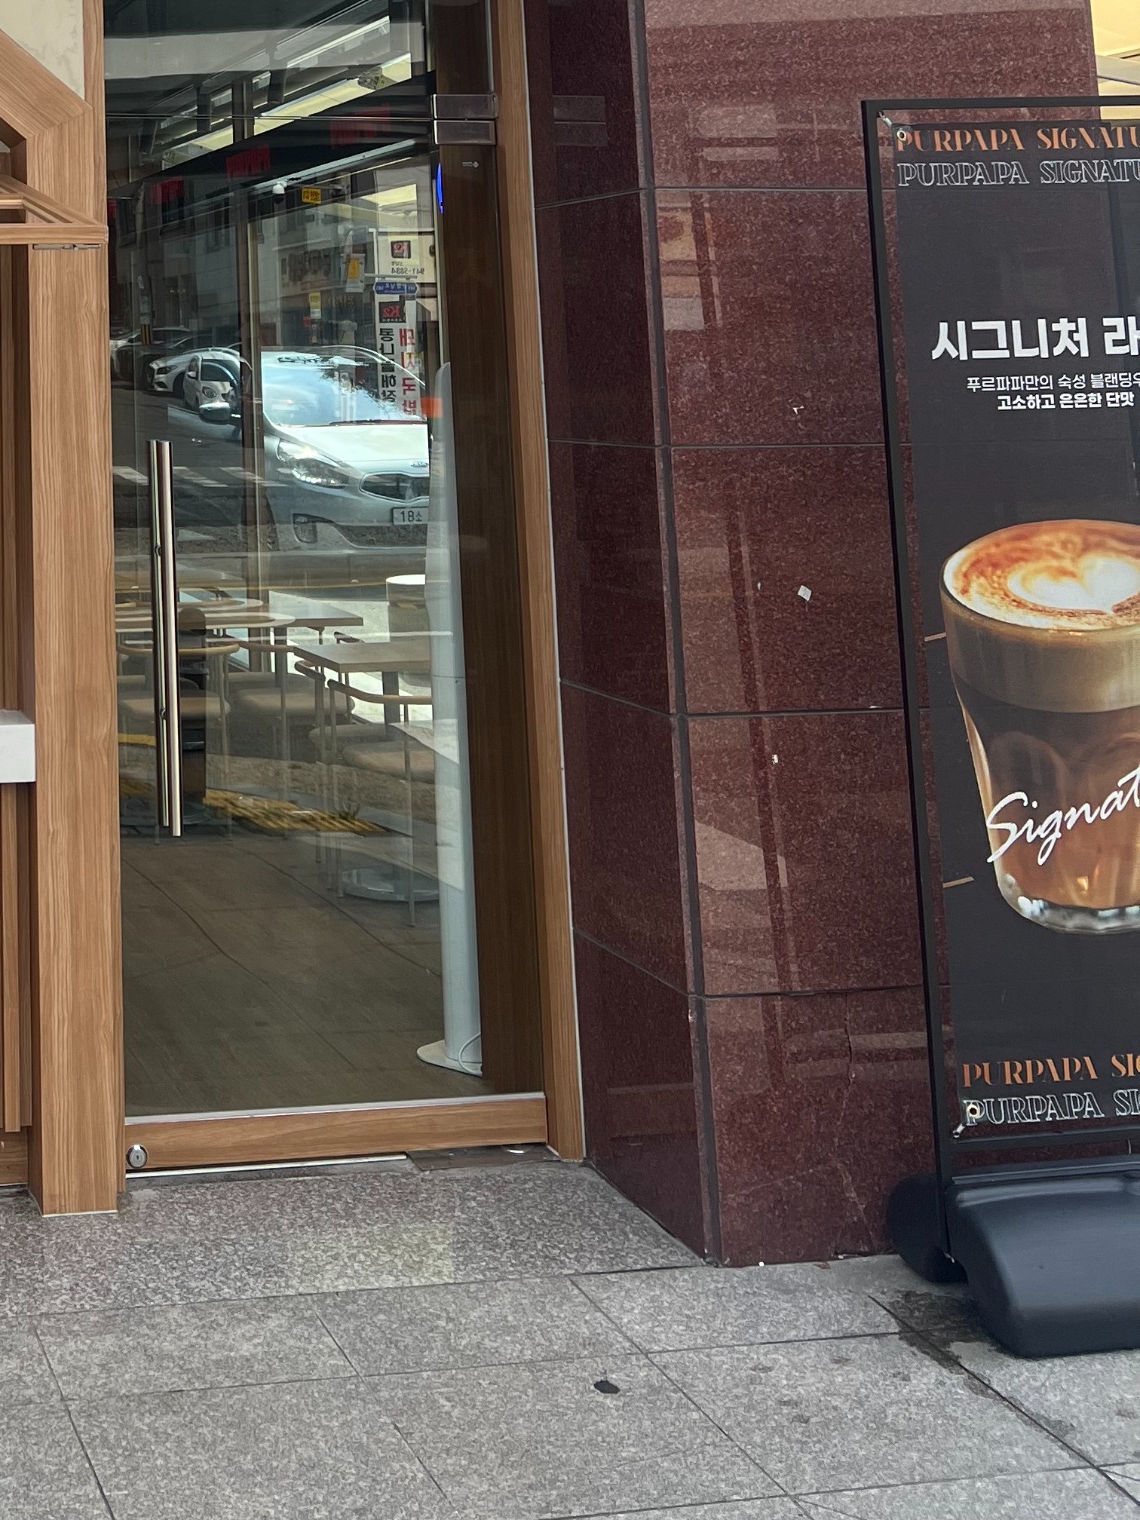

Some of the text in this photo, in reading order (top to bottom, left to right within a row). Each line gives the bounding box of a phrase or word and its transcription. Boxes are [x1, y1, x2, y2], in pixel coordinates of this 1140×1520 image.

[897, 128, 1026, 152] PURPAPA
[897, 160, 1029, 186] PURPAPA
[932, 318, 1089, 360] 시그니처
[967, 375, 1054, 392] 푸르파파만의
[1058, 374, 1086, 389] 숙성
[998, 392, 1134, 410] 고소하고 은은한 단맛
[963, 1055, 1097, 1087] PURPAPA
[963, 1092, 1105, 1126] PURPAPA
